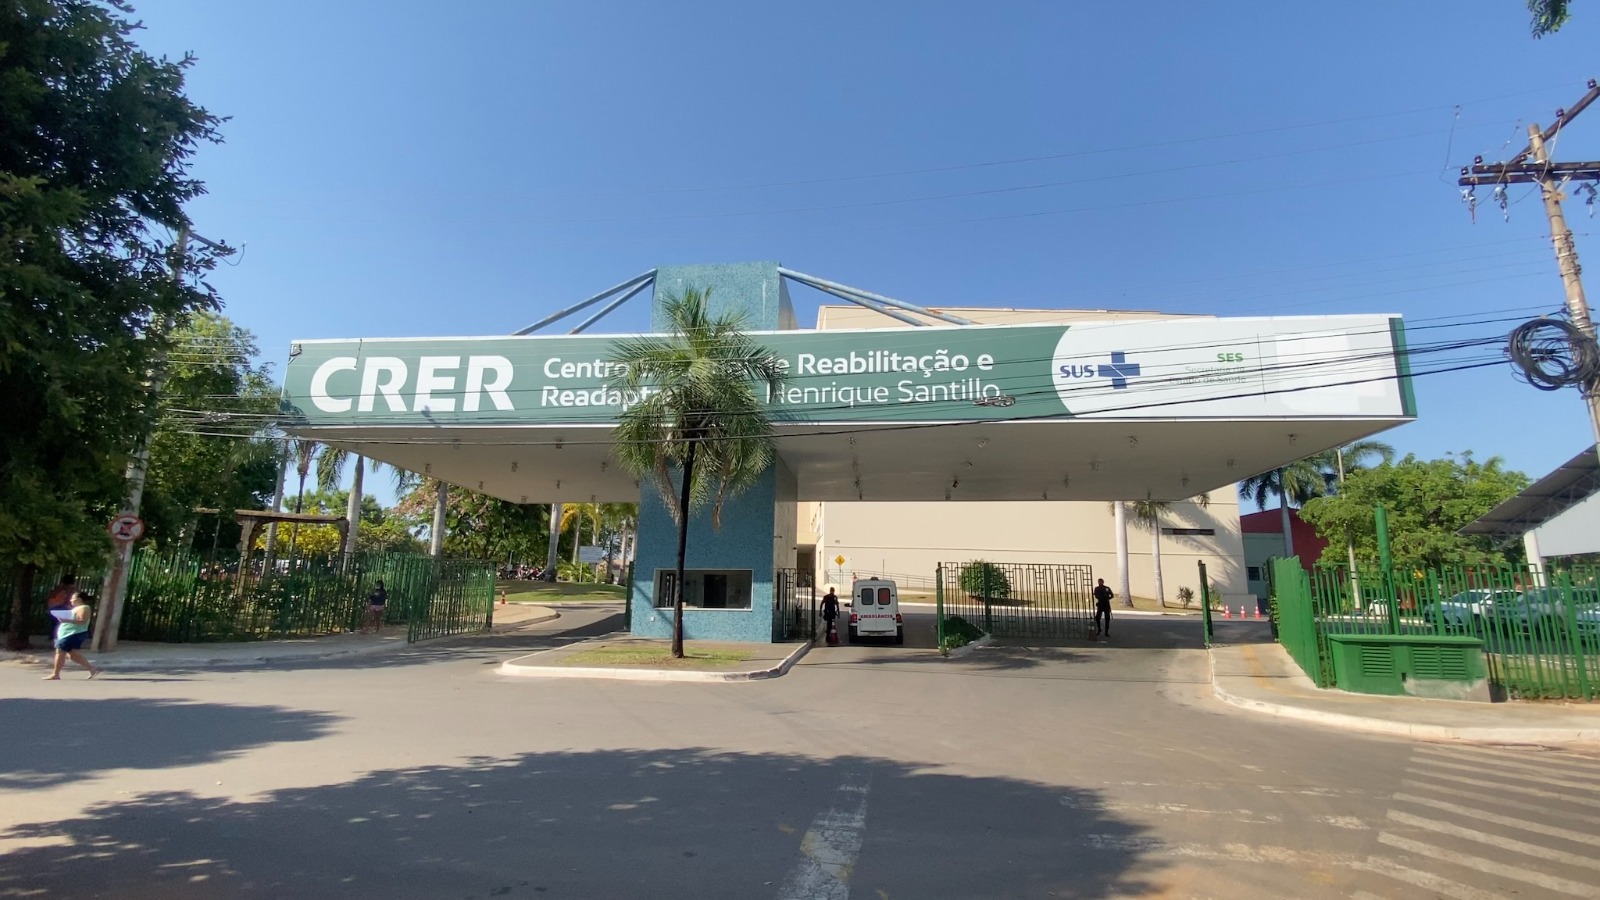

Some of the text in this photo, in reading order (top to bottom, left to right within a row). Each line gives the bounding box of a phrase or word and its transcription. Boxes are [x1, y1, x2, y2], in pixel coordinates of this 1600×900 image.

[543, 357, 630, 379] Centro
[797, 349, 970, 377] Reabilitação
[976, 353, 994, 371] e
[1060, 365, 1094, 378] SUS
[1217, 353, 1244, 362] SES
[310, 355, 514, 413] CRER
[766, 381, 889, 408] Henrique
[897, 378, 1000, 403] Santillo
